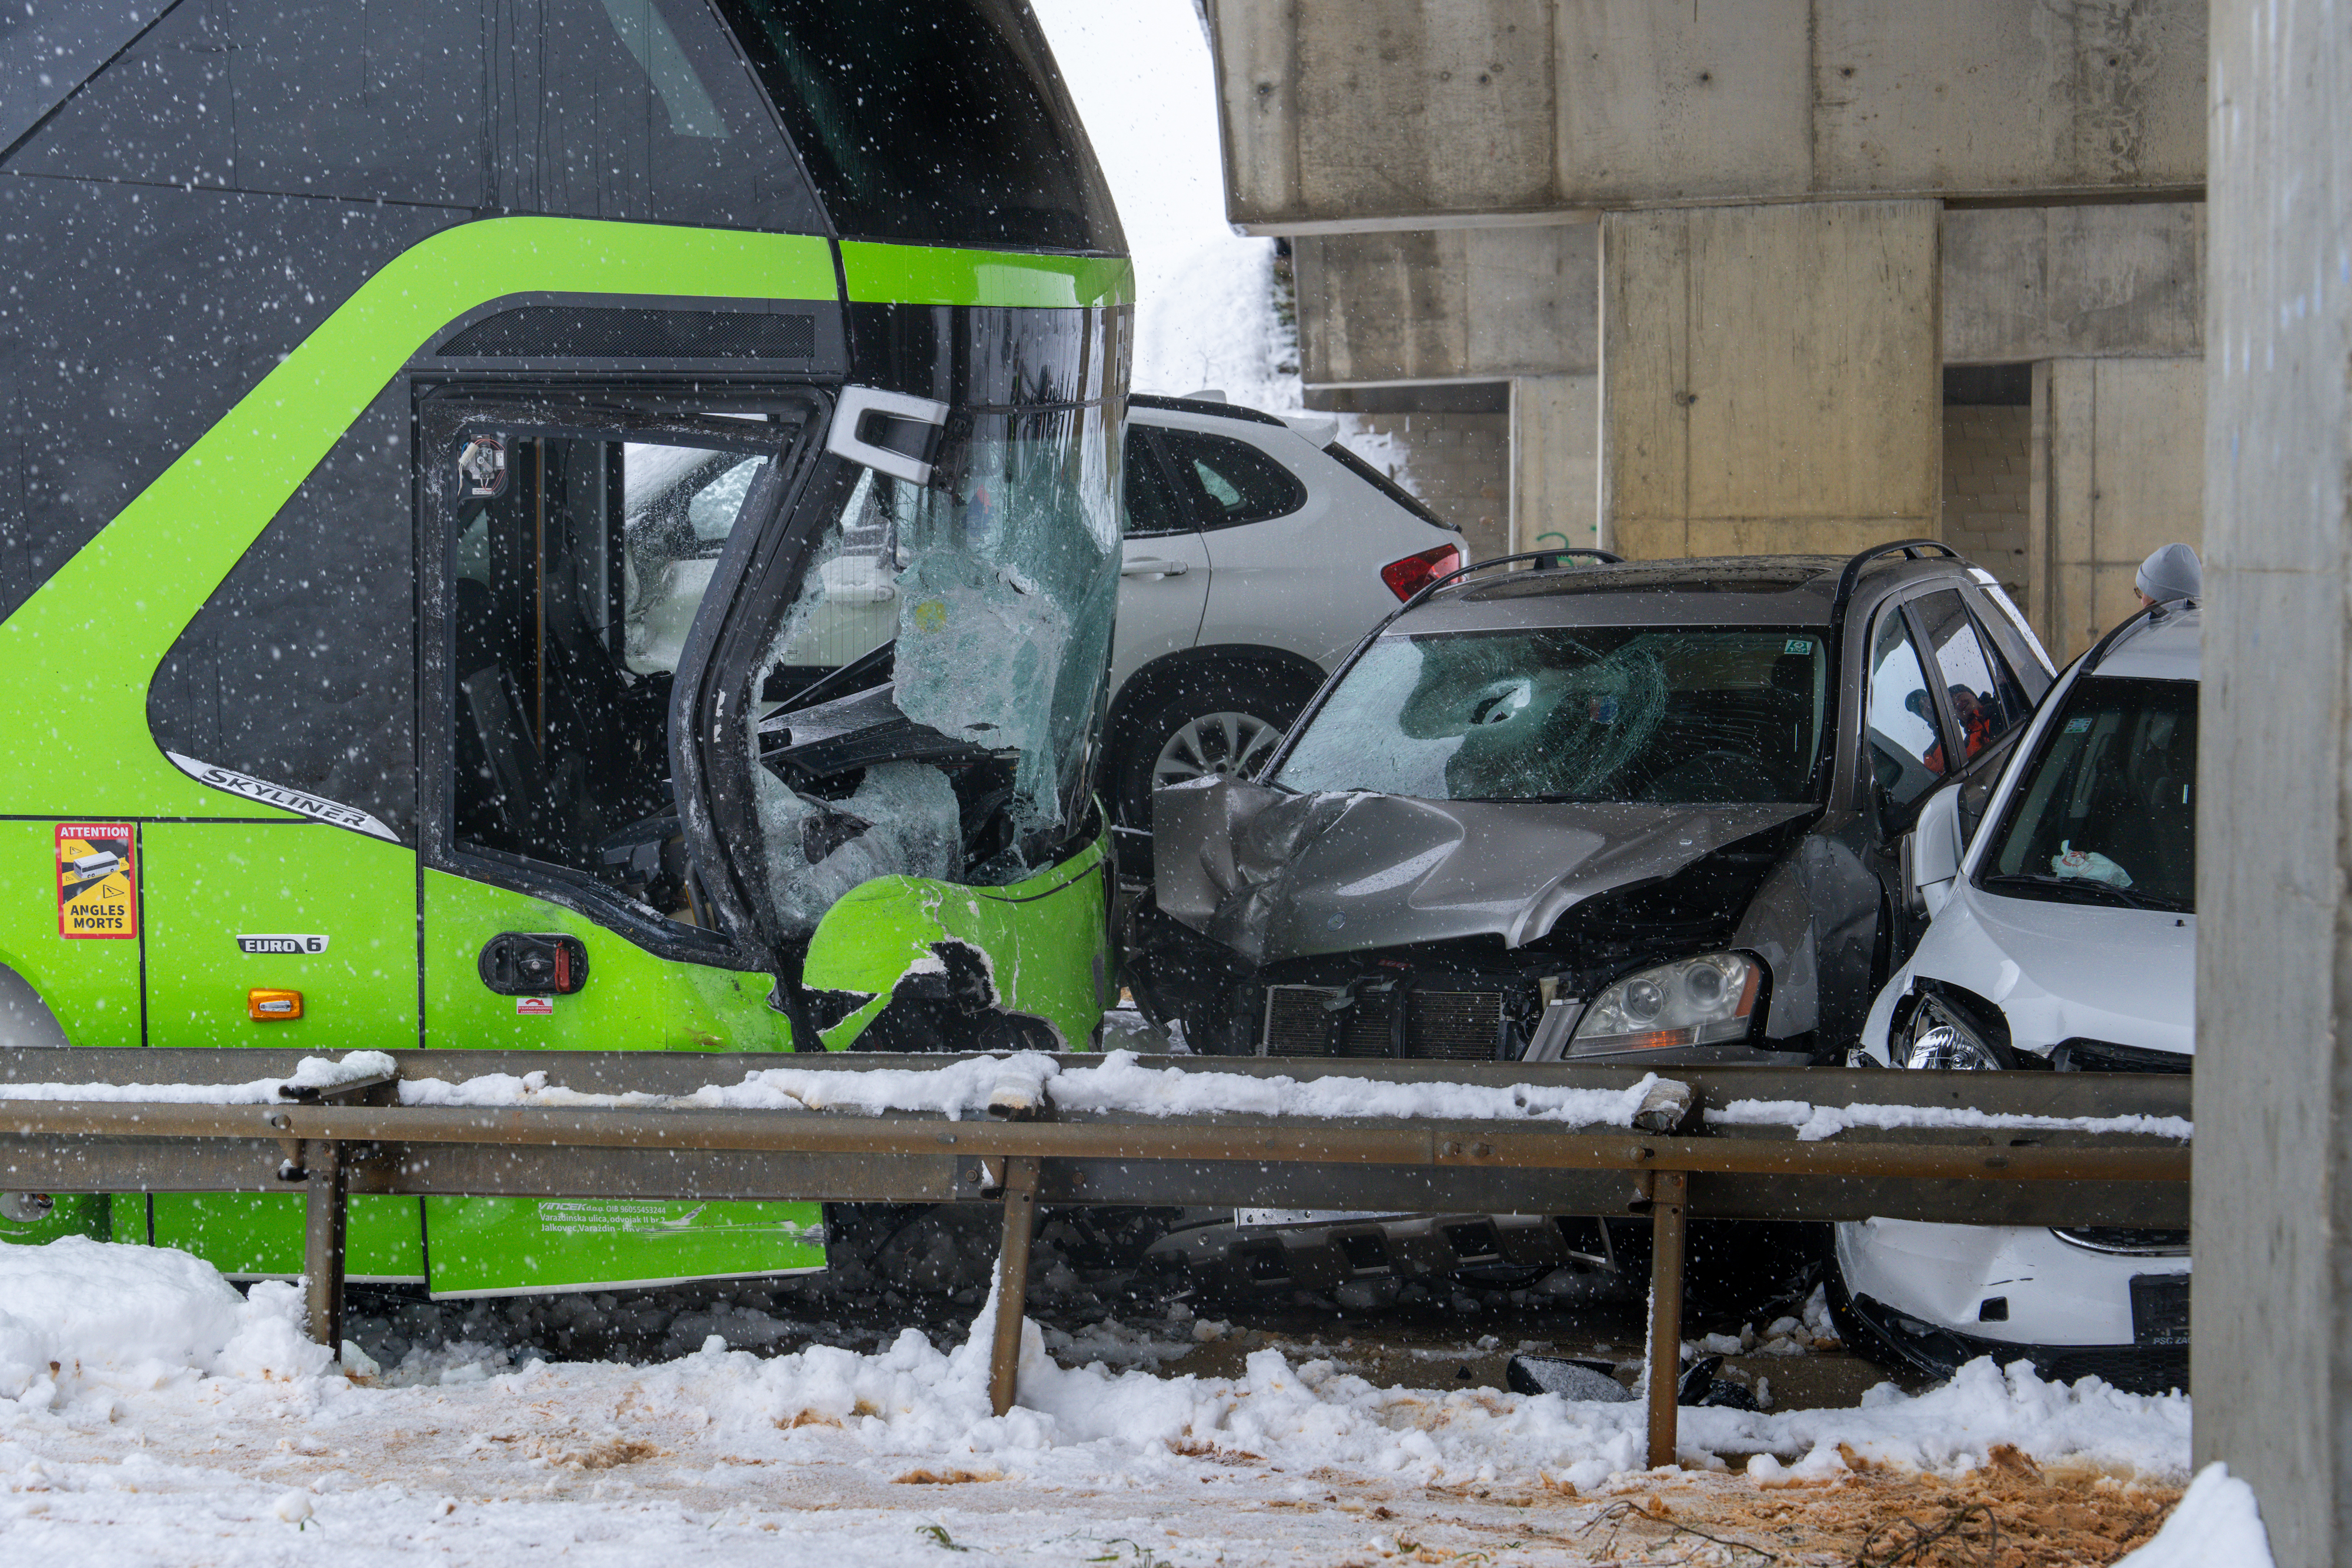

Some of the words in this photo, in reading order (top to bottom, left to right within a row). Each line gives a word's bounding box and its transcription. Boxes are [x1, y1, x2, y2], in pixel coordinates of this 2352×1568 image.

[202, 769, 366, 827] SKYLINER
[60, 827, 129, 837] ATTENTION
[70, 905, 125, 916] ANGLES
[74, 918, 123, 928] MORTS
[245, 940, 296, 952] EURO
[306, 937, 322, 952] 6
[620, 1205, 666, 1213] 96055453244
[540, 1213, 586, 1222] Varaždinska
